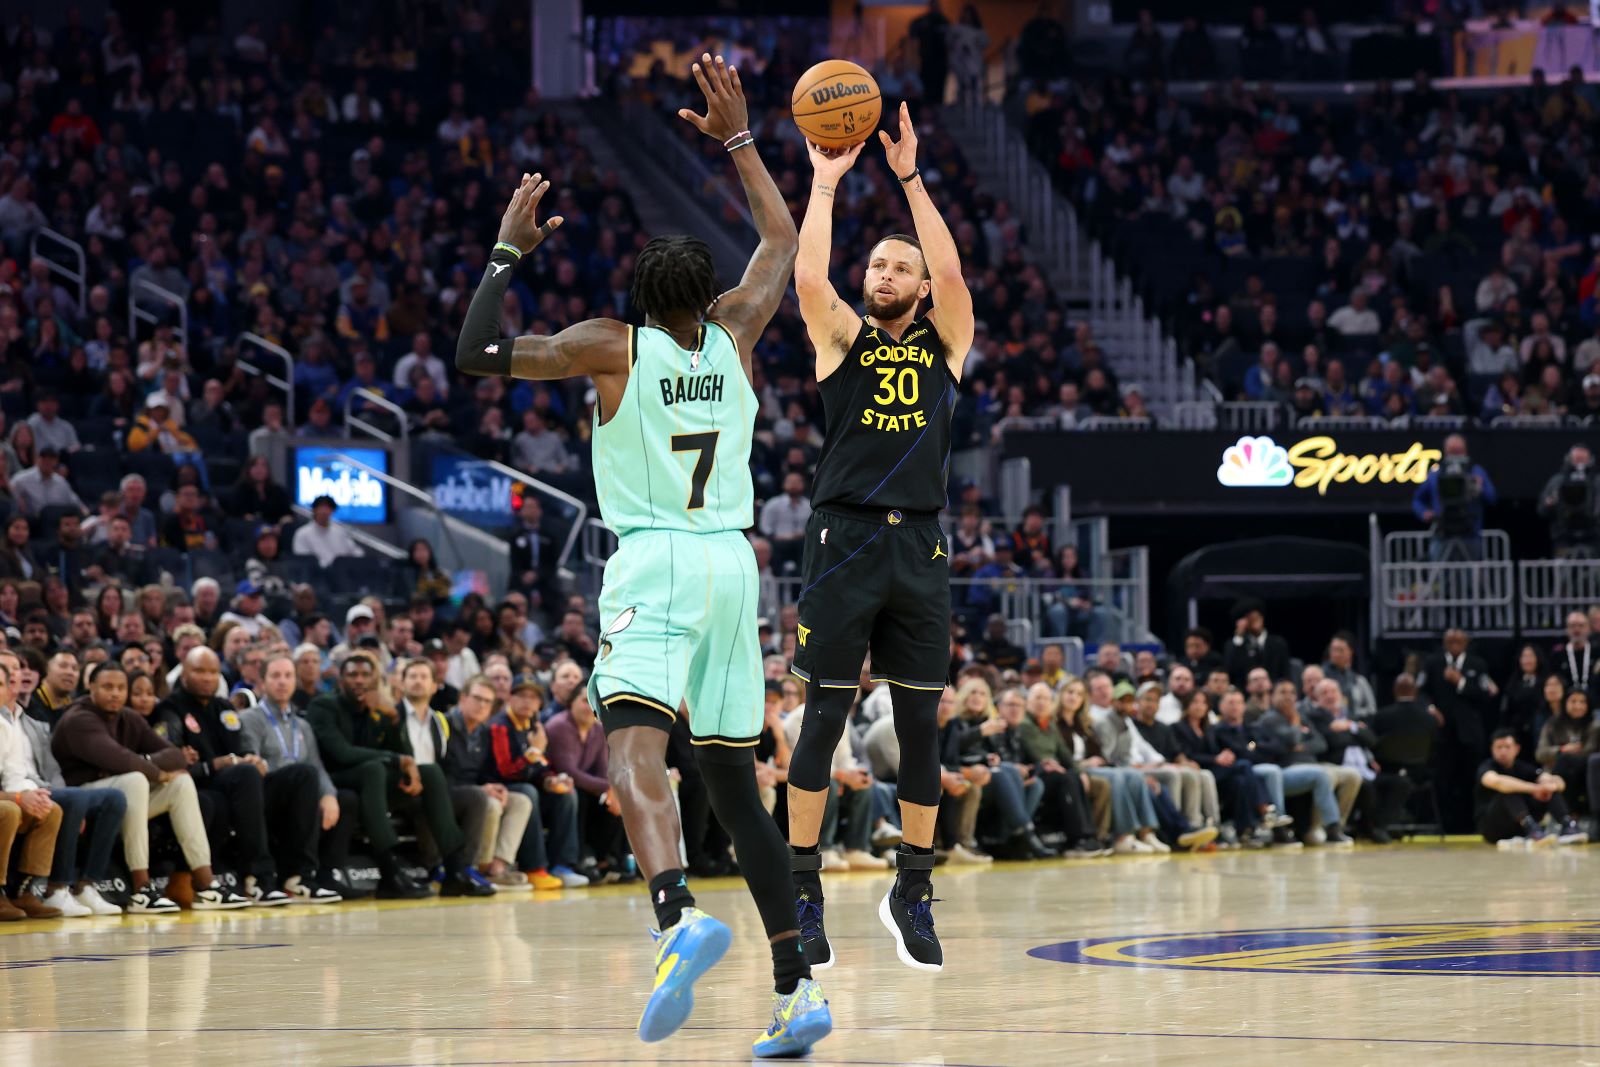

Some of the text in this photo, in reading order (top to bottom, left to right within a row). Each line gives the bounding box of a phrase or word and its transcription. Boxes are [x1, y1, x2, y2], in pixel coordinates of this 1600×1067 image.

[810, 82, 871, 105] Wilson
[660, 375, 724, 406] BAUGH
[874, 367, 919, 405] 30
[861, 408, 927, 432] STATE
[671, 431, 720, 510] 7
[1288, 436, 1442, 496] Sports
